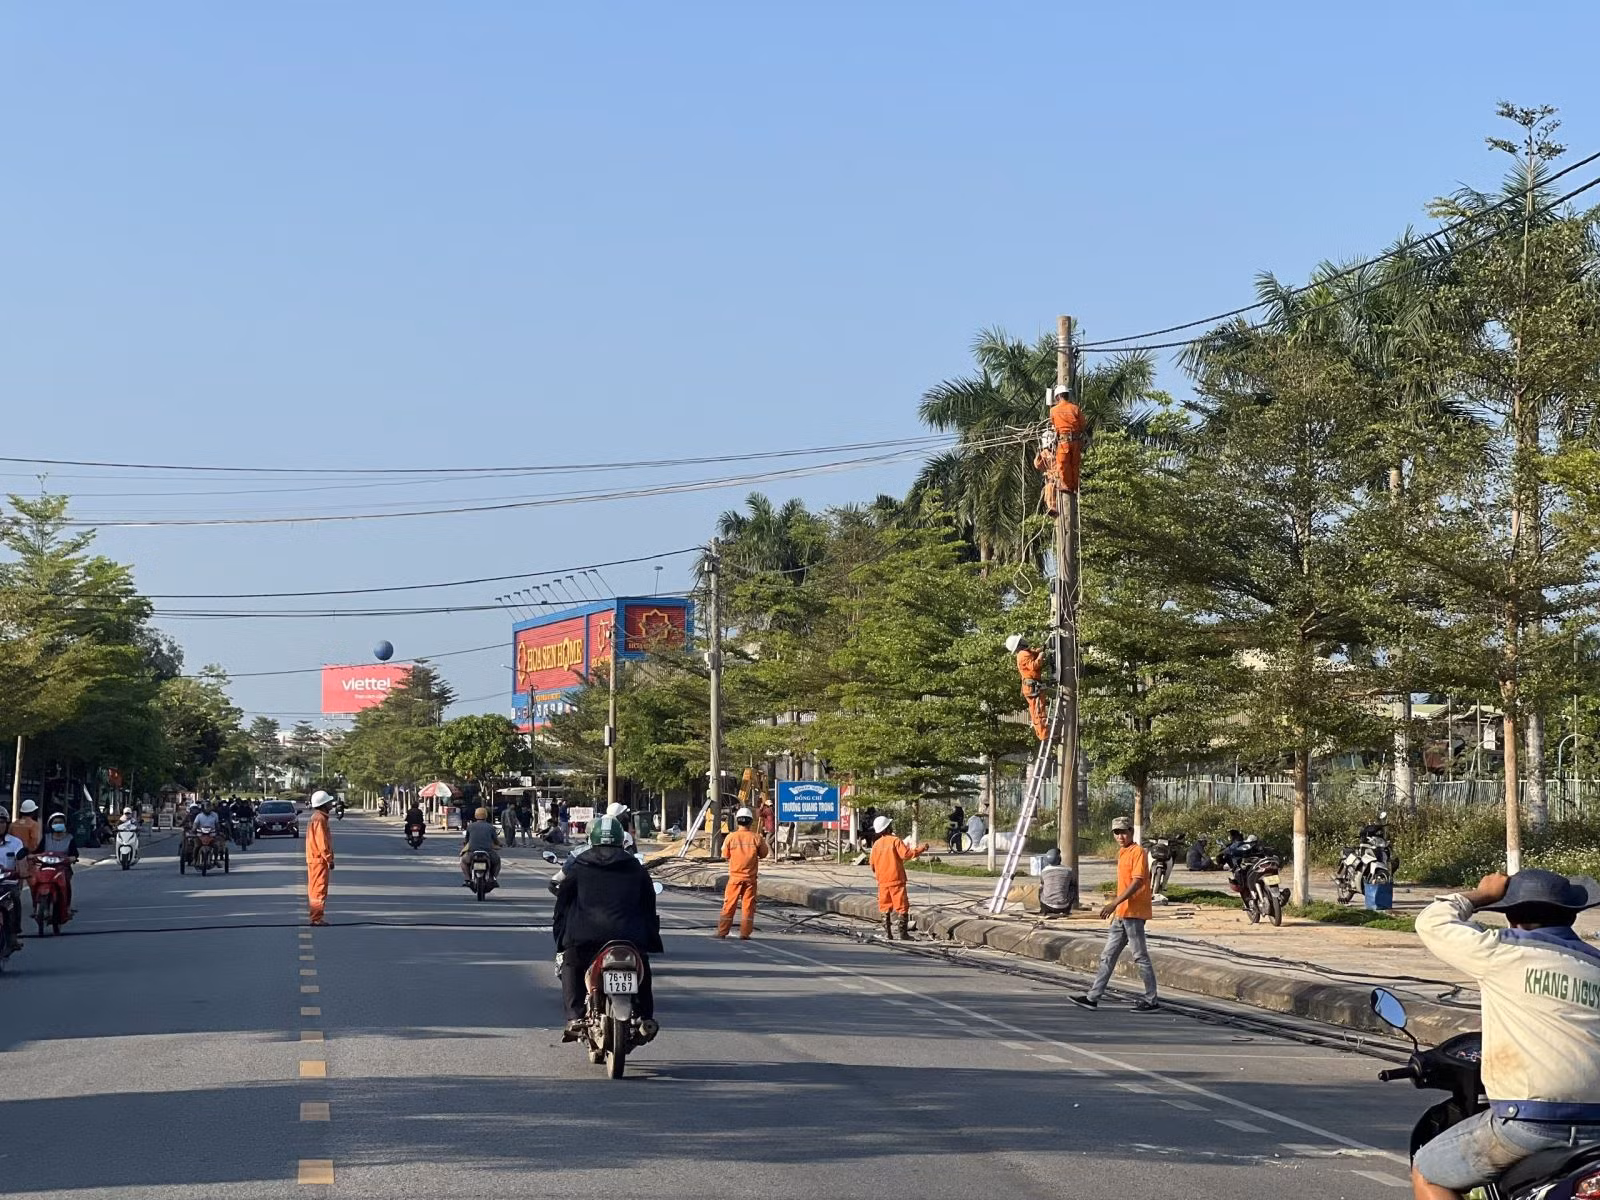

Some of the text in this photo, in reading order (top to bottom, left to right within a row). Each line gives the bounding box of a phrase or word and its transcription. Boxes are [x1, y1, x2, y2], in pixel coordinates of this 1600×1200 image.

[527, 647, 542, 672] HOA
[542, 644, 557, 670] SEN
[557, 637, 582, 672] HOME
[342, 677, 391, 691] viettel
[609, 982, 632, 992] 1267
[1524, 967, 1569, 1000] KHANG
